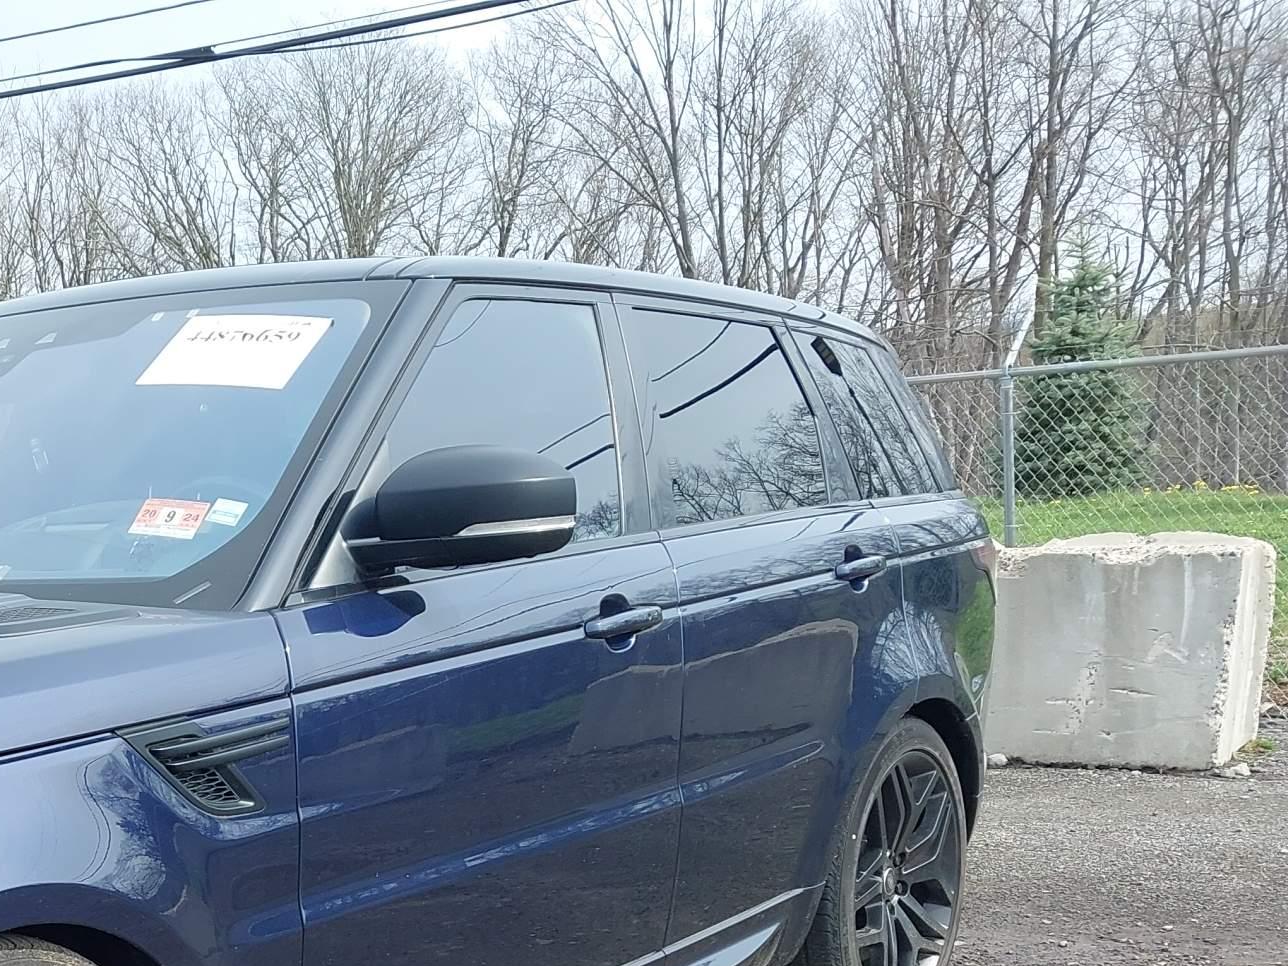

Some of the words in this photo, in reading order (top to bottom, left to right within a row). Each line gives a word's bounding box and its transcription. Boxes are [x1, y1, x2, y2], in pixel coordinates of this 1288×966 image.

[141, 508, 158, 519] 20
[164, 510, 177, 523] 9
[183, 512, 200, 523] 24
